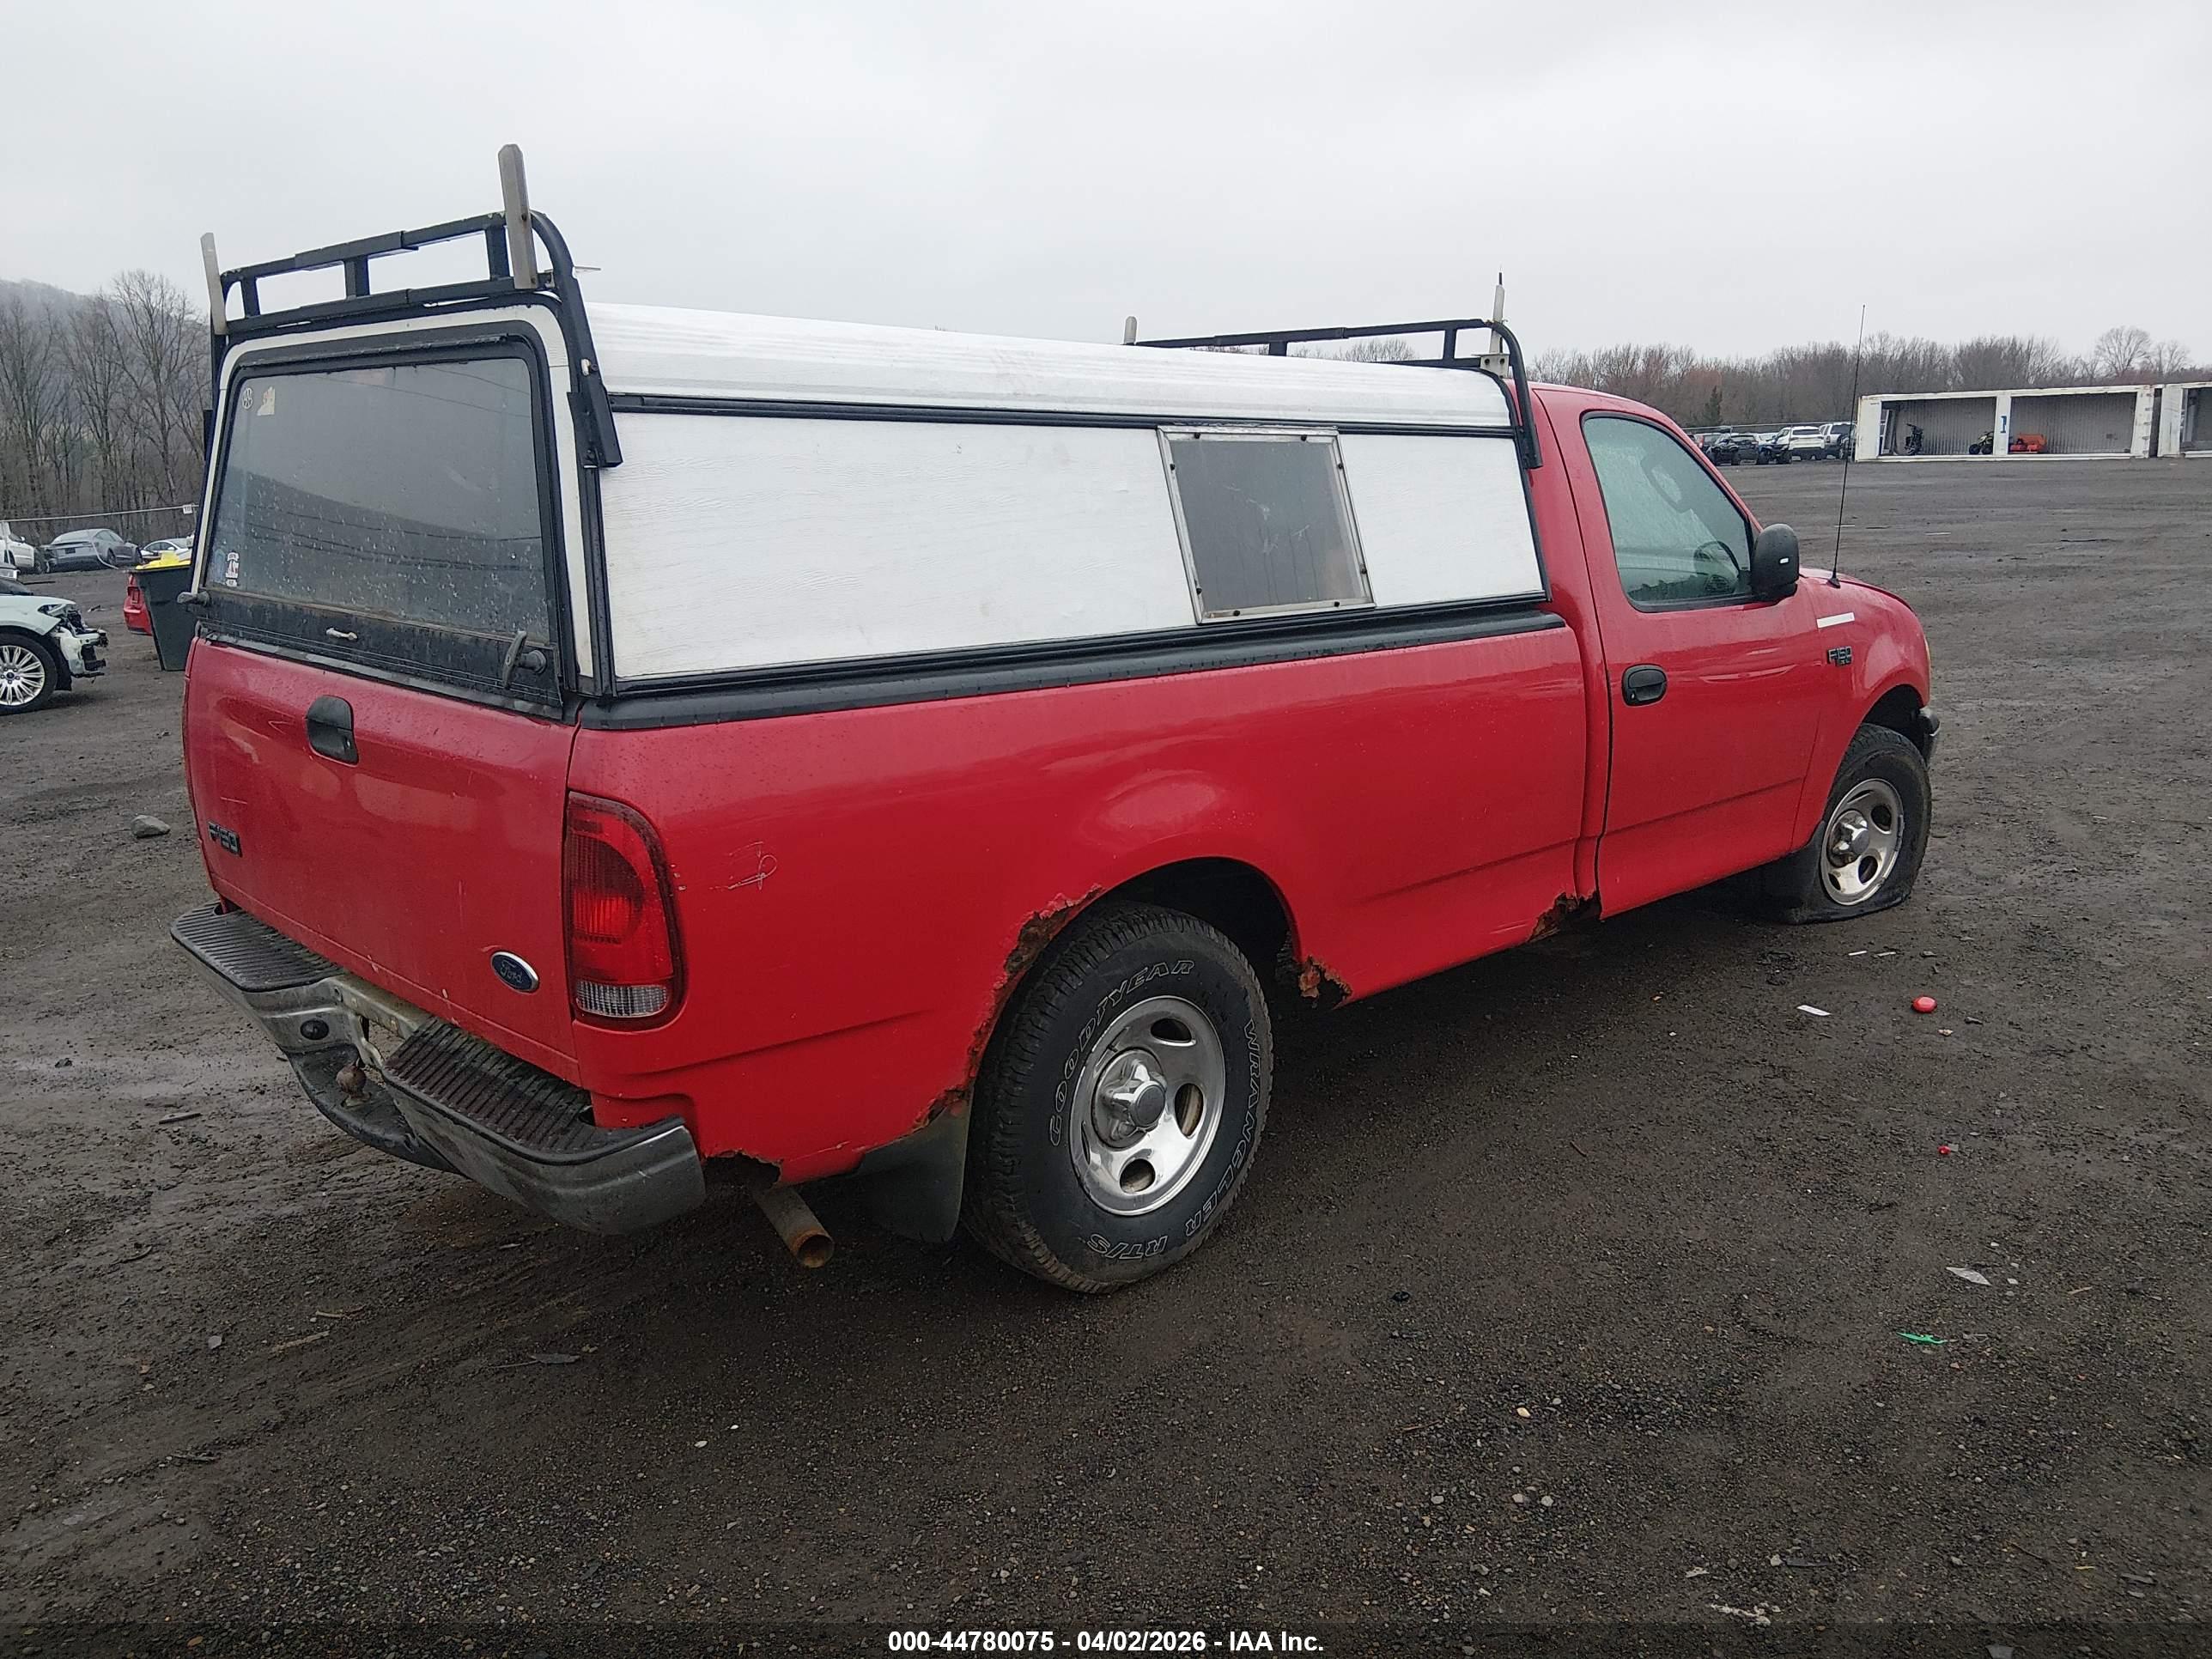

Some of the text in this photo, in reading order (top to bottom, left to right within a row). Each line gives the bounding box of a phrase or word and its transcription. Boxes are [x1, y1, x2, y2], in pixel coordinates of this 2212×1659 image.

[1049, 960, 1262, 1261] GOODYEAR WRANGLER RT/S
